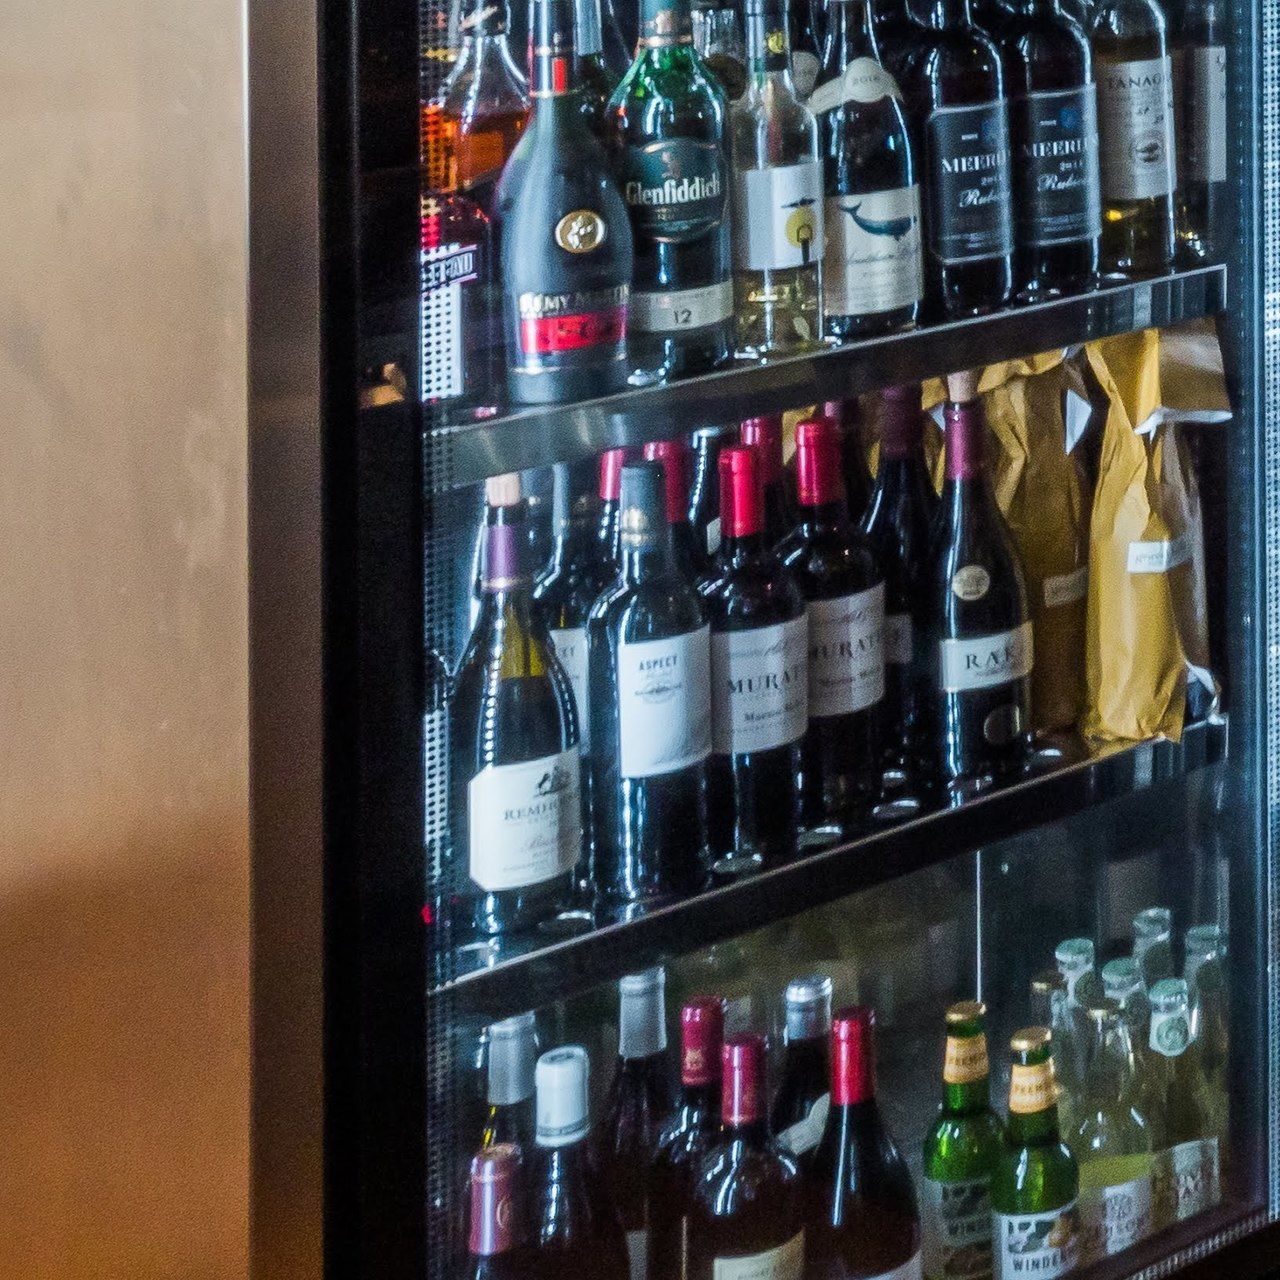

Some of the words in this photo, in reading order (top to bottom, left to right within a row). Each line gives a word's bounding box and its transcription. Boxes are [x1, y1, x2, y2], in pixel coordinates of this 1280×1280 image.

[625, 172, 721, 206] Glenfiddich
[673, 308, 692, 325] 12
[638, 654, 678, 671] ASPECT
